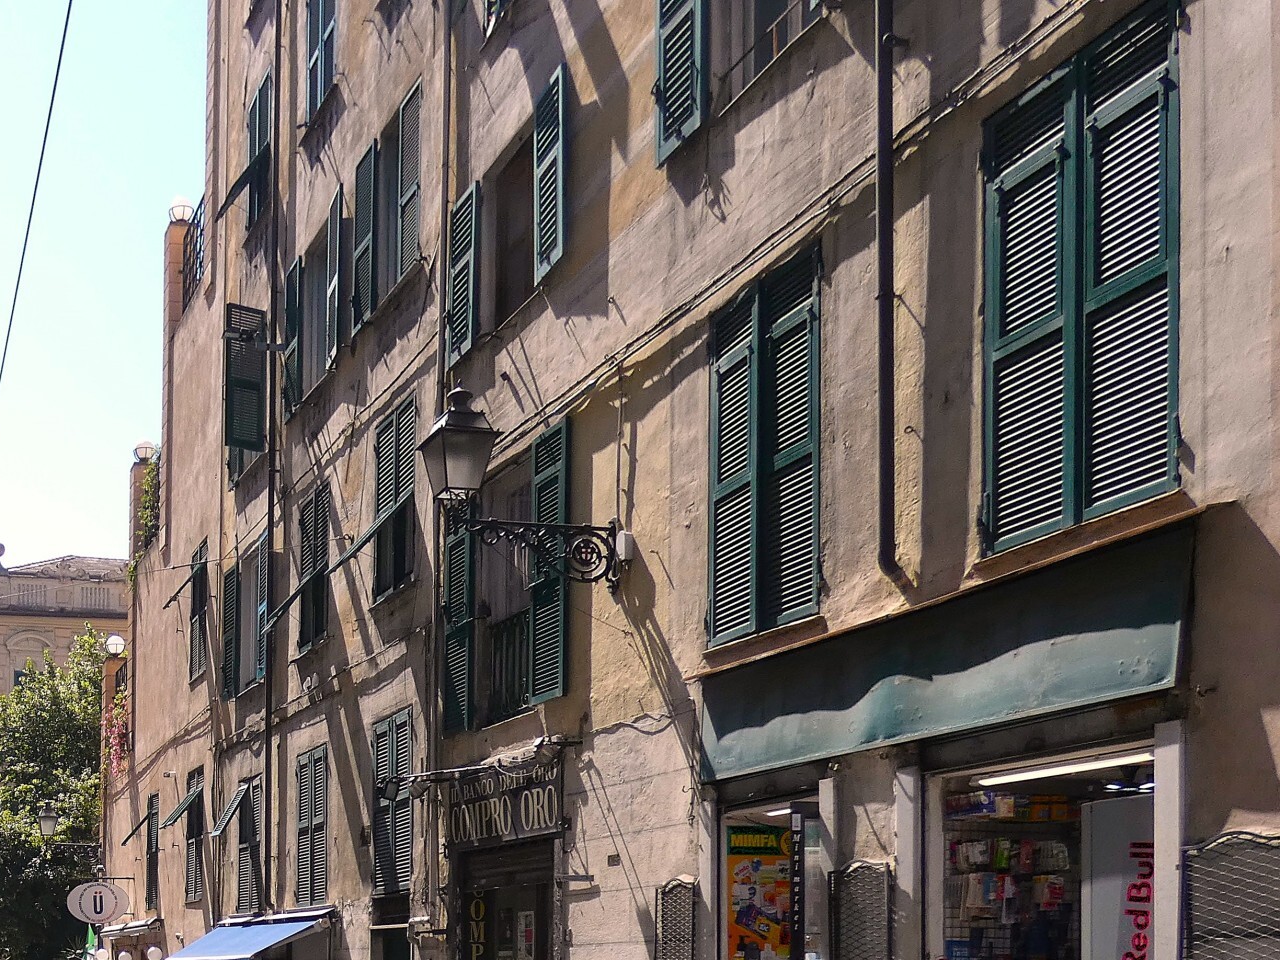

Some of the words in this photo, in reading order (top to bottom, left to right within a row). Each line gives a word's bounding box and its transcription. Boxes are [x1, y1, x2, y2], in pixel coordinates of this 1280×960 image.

[451, 787, 460, 803] IL
[463, 778, 494, 800] BANCO
[532, 762, 557, 783] ORO
[451, 795, 512, 844] COMPRO
[520, 784, 558, 831] ORO
[730, 834, 778, 847] MIMFA
[792, 833, 800, 871] Mini
[1126, 841, 1154, 904] Bull
[93, 891, 104, 915] Ü
[792, 876, 801, 930] market
